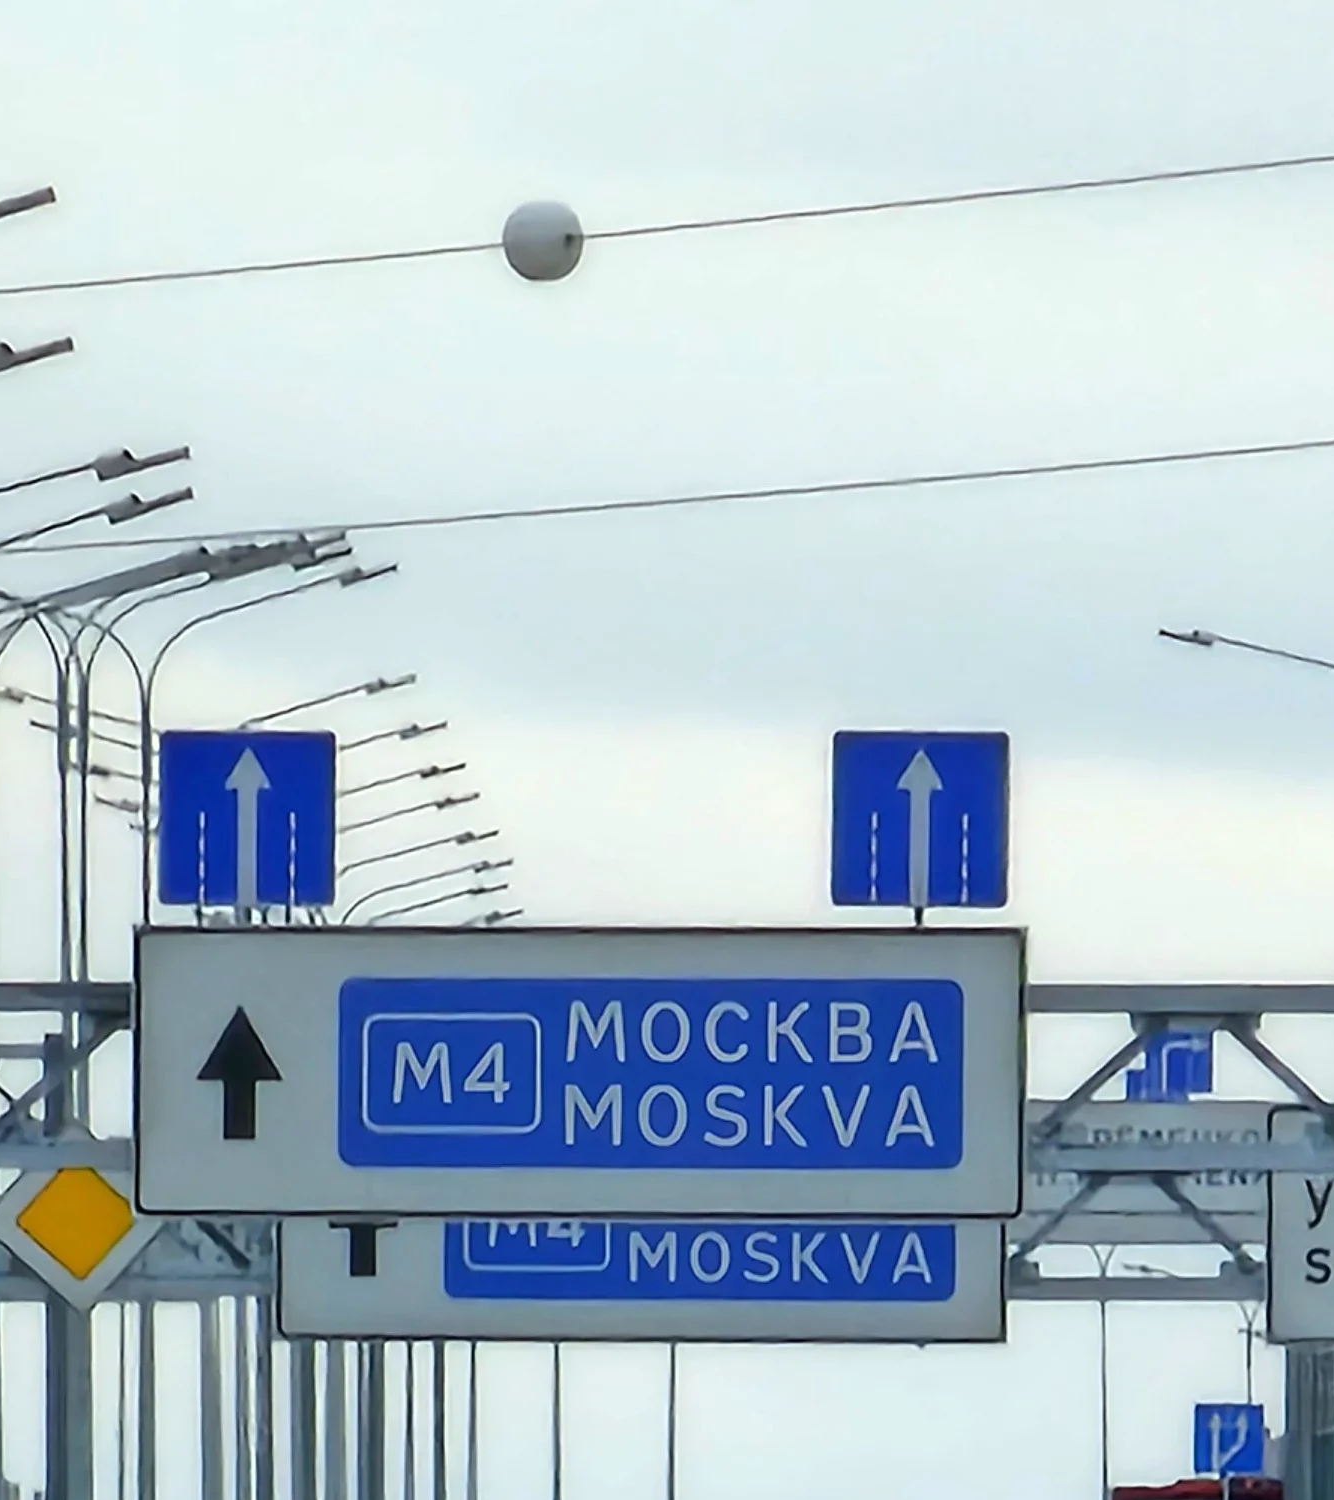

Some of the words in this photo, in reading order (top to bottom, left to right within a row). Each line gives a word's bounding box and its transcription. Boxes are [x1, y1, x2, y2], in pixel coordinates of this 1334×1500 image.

[565, 1000, 939, 1064] МОСКВА
[392, 1041, 511, 1105] М4
[564, 1083, 935, 1148] MOSKVA
[628, 1230, 933, 1284] MOSKVA
